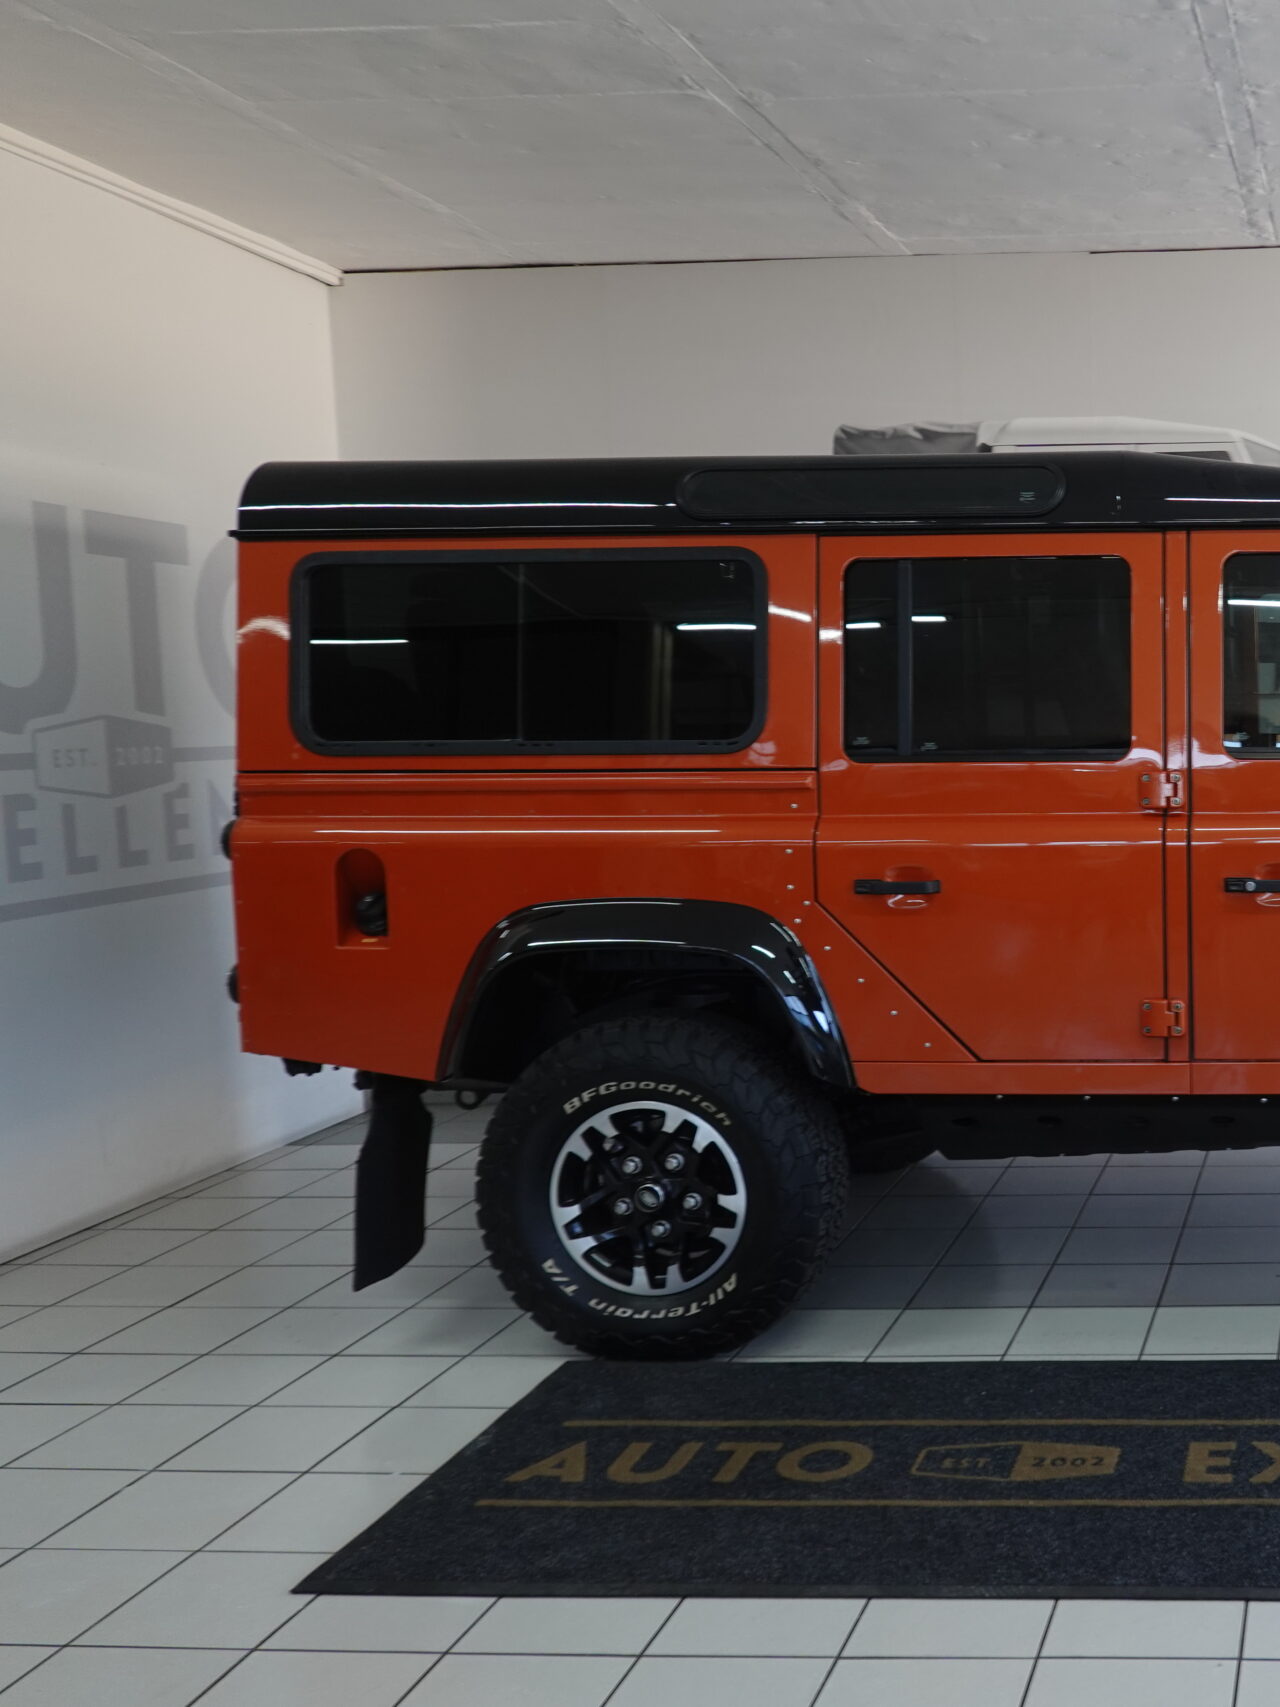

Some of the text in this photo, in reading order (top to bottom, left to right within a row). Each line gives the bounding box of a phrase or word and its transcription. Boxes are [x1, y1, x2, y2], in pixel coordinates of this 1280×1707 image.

[115, 745, 164, 767] 2002
[562, 1081, 732, 1127] BFGoodrich
[541, 1258, 739, 1319] All-Terrain T/A
[503, 1440, 874, 1484] AUTO
[1031, 1456, 1105, 1468] 2002
